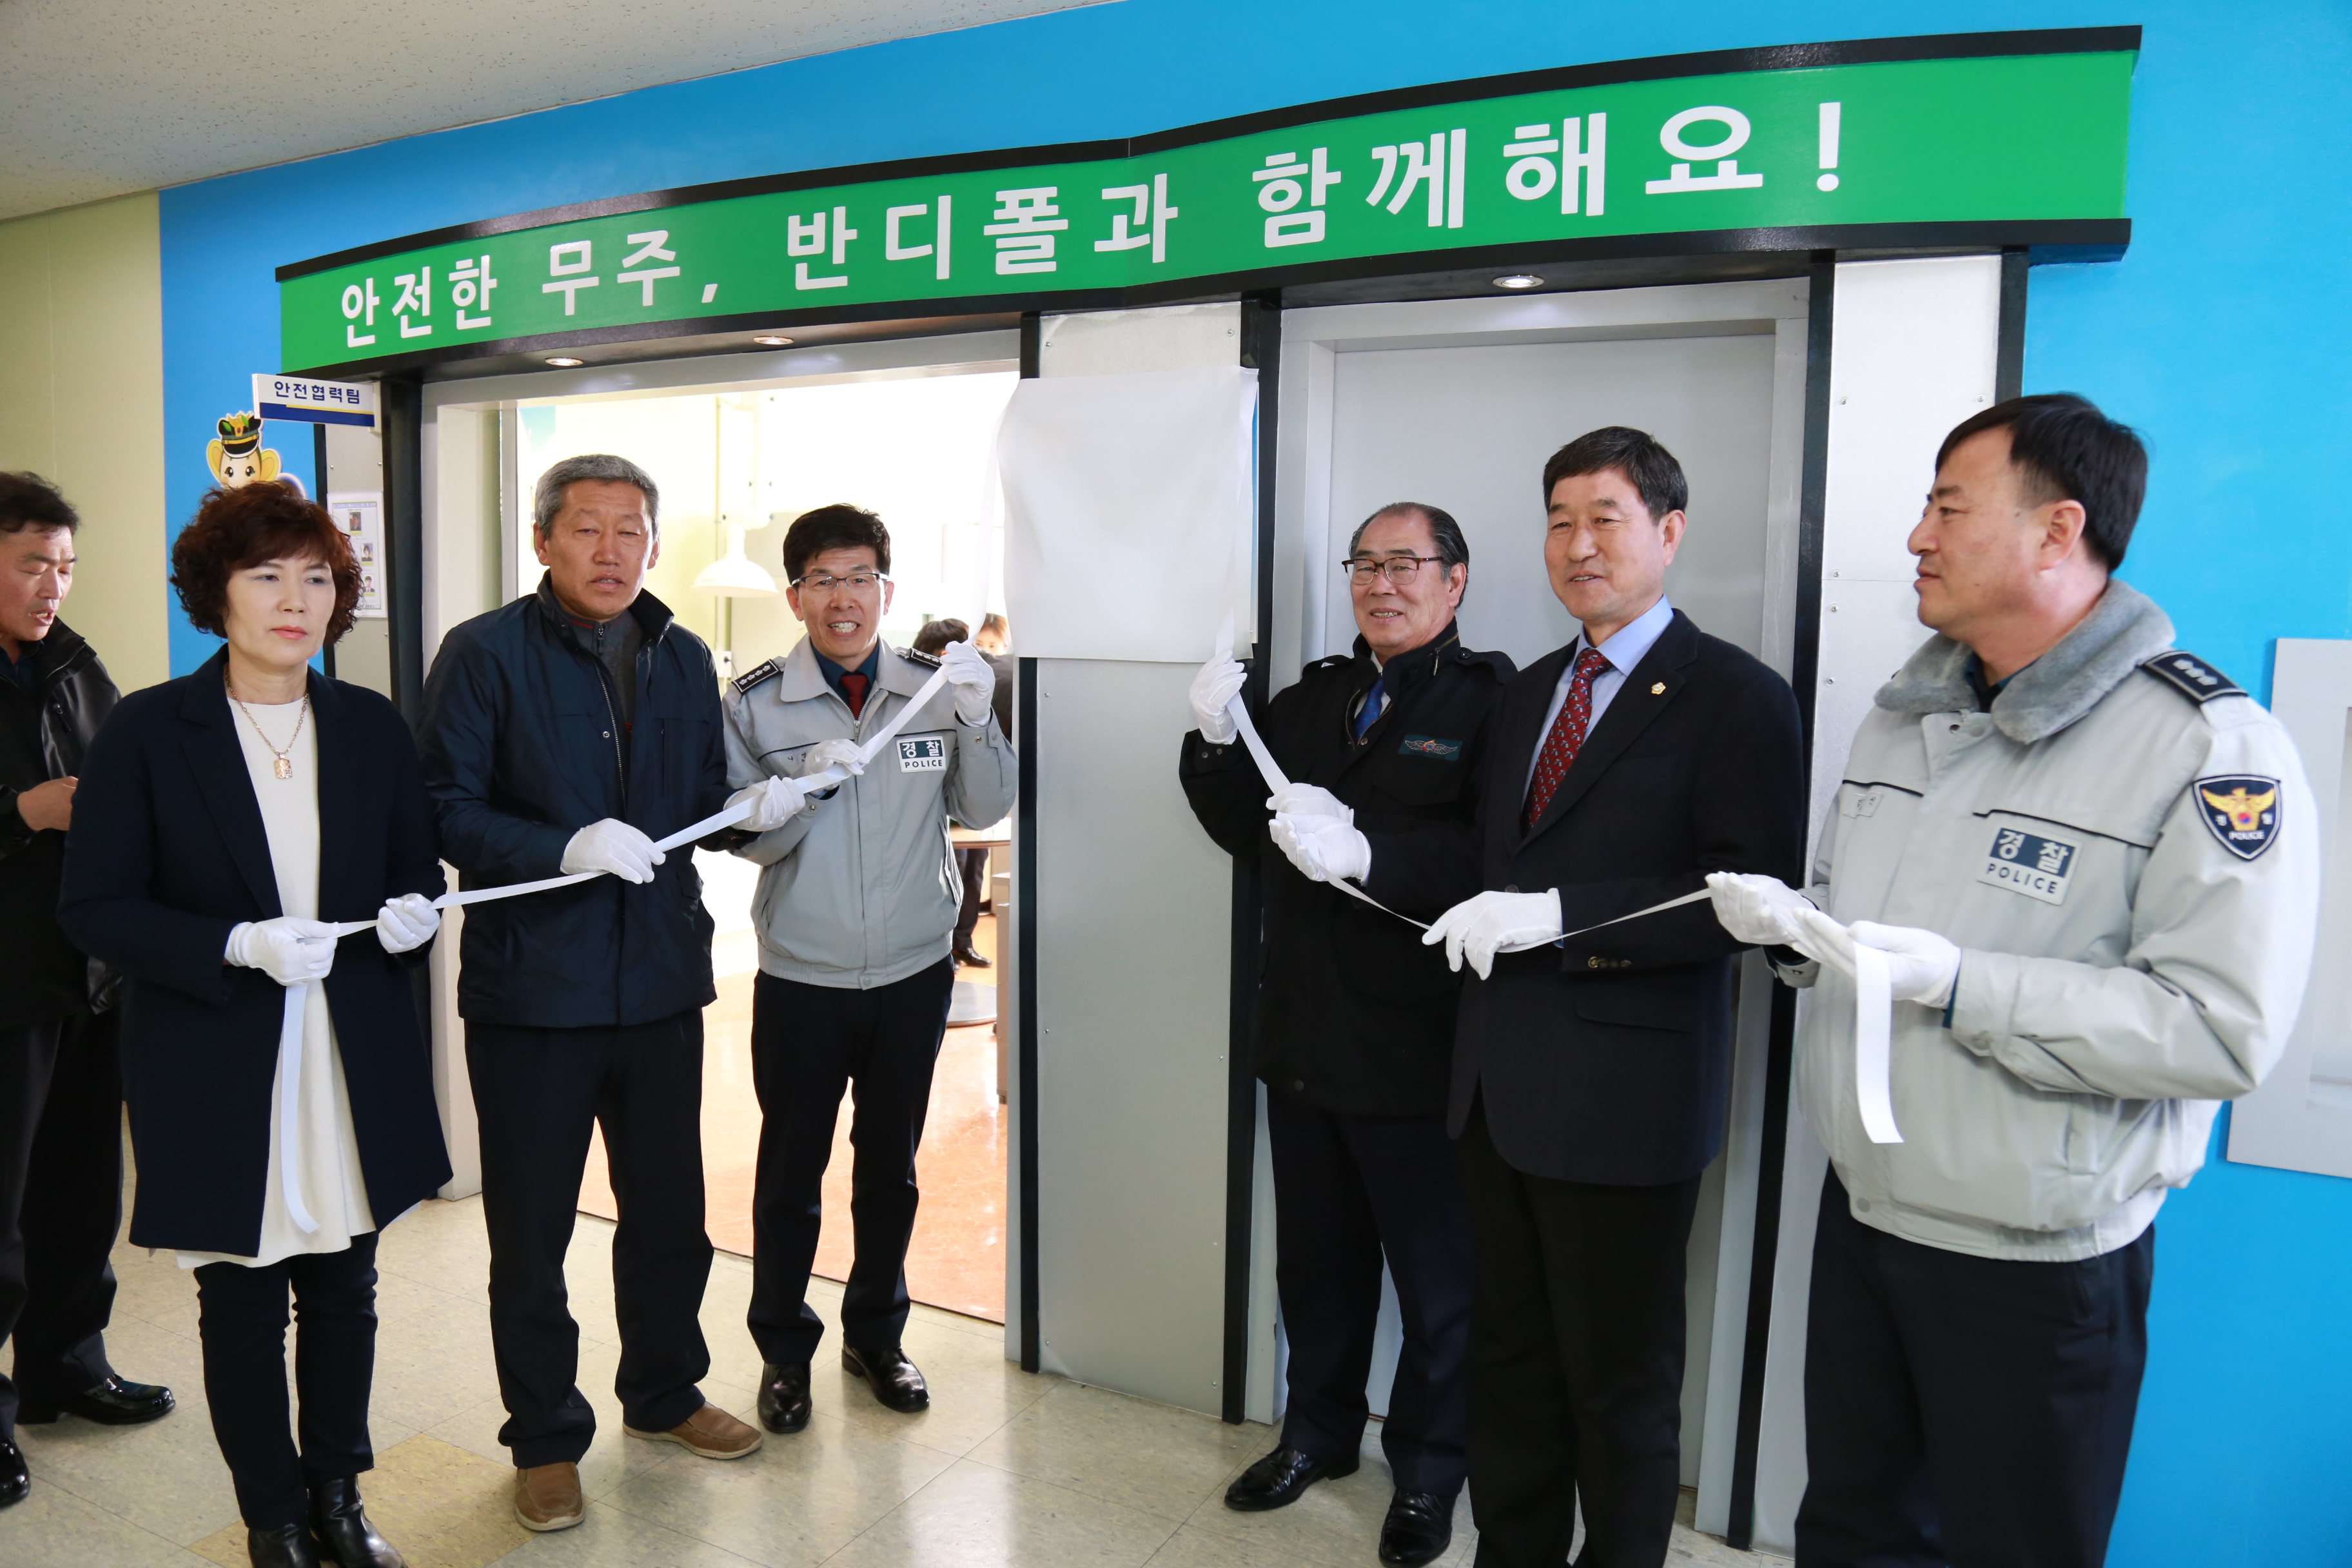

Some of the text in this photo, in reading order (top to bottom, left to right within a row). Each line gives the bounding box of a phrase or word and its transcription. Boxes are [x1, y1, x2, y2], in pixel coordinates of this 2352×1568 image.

[342, 255, 498, 348] 안전한
[542, 230, 718, 317] 무주,
[787, 173, 1179, 291] 반디폴과
[274, 381, 360, 404] 안전협력팀
[905, 760, 943, 769] POLICE
[1985, 863, 2058, 894] POLICE
